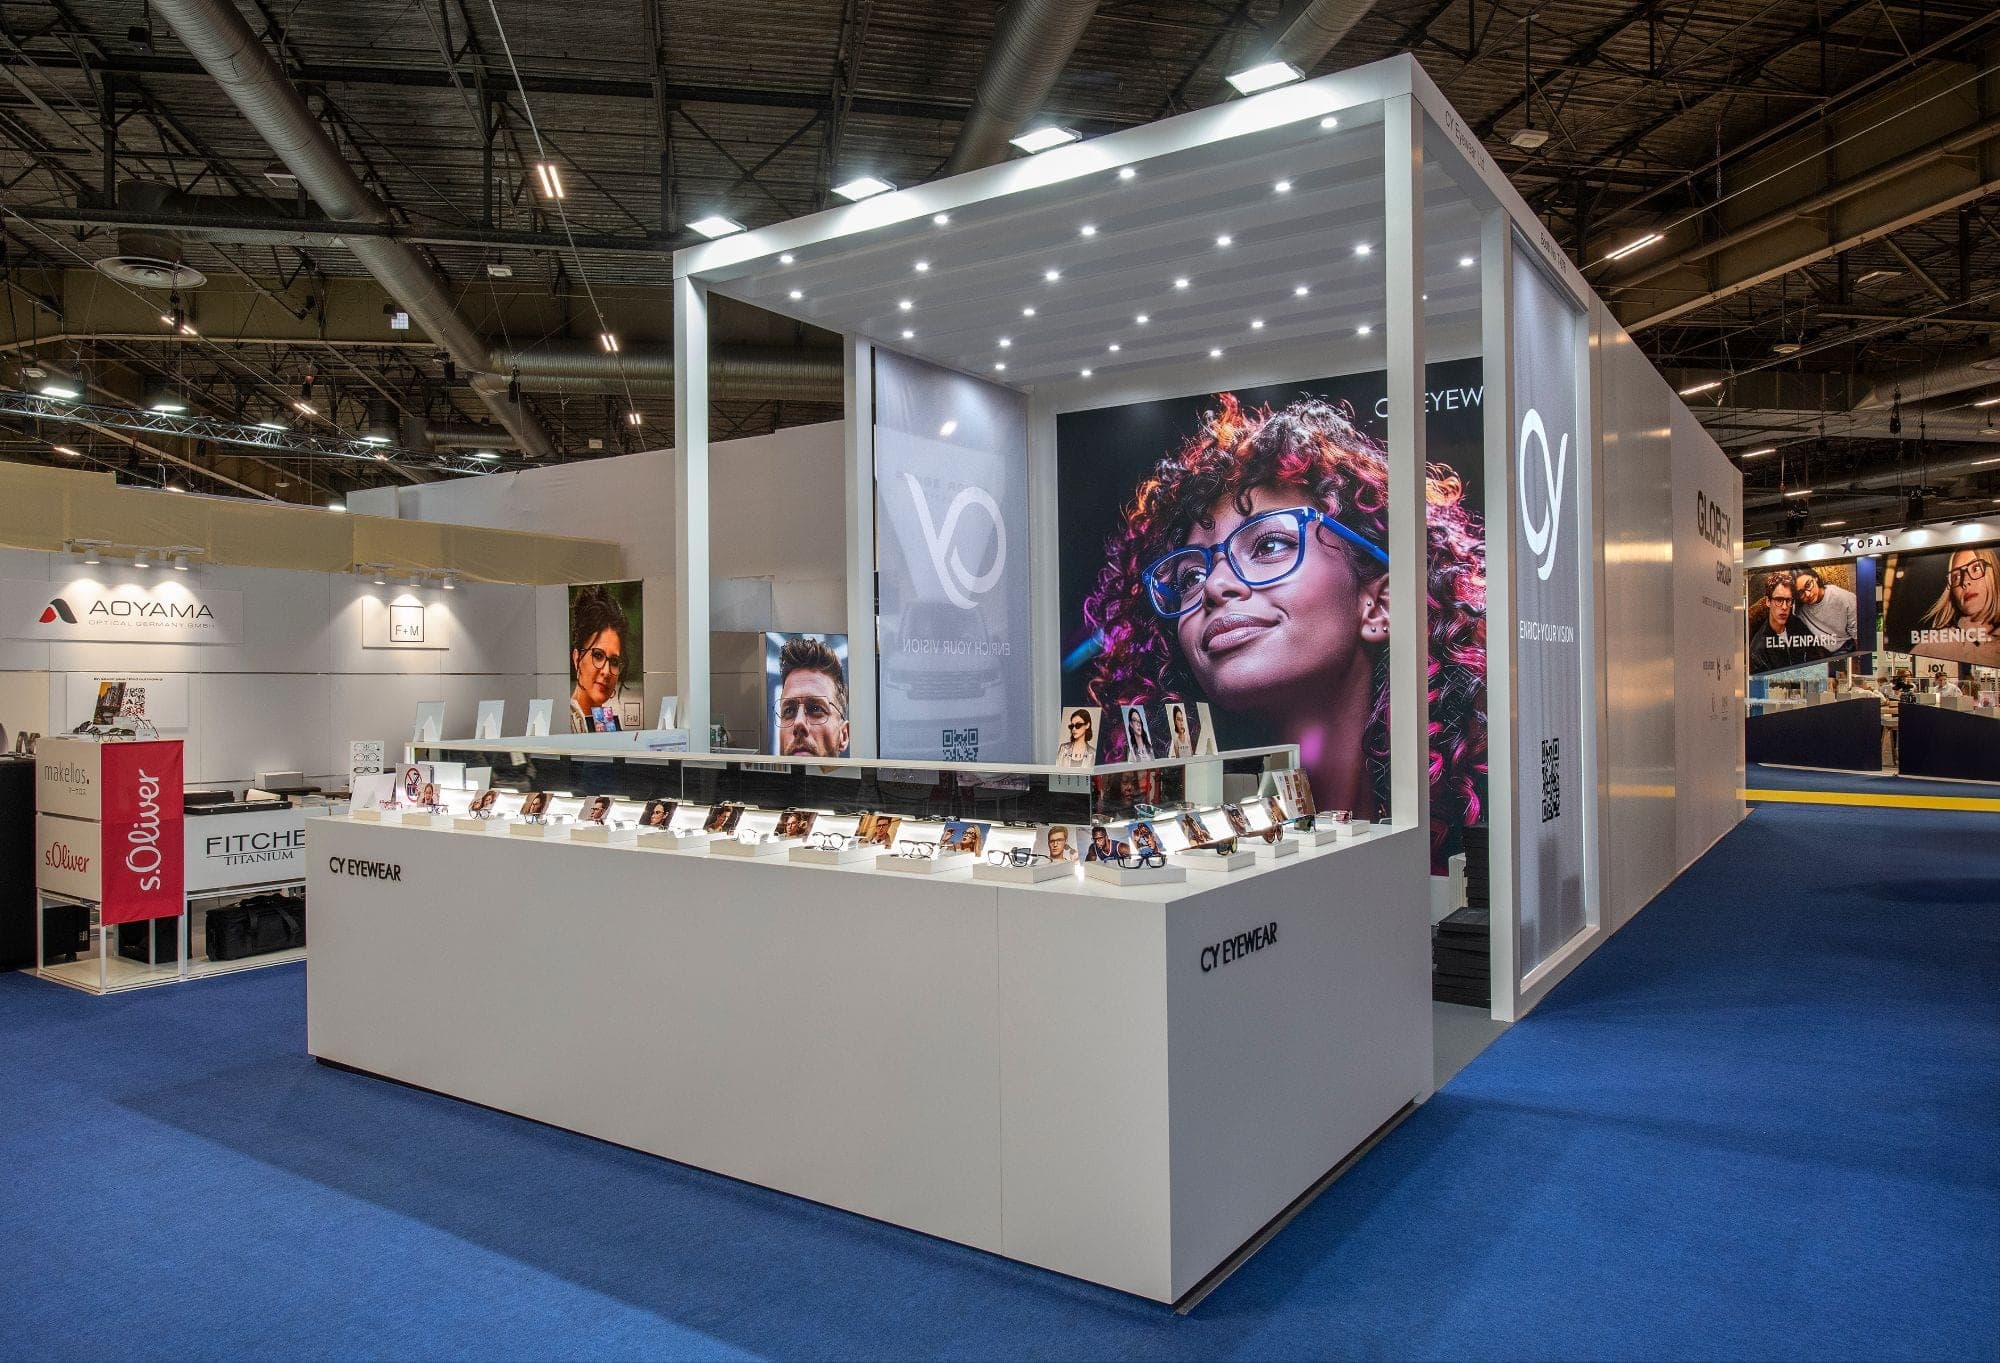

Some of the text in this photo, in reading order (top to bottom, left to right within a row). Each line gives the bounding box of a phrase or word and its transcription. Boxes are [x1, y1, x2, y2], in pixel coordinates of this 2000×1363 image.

[1374, 385, 1484, 418] C YEW
[1697, 489, 1731, 556] GLOBEX
[1857, 536, 1891, 549] OPAL
[89, 599, 215, 619] AOYAMA
[88, 619, 132, 627] OPTICAL
[135, 621, 184, 629] GERMANY
[395, 624, 419, 636] F+M
[1540, 623, 1557, 642] YOUR
[1765, 633, 1838, 649] ELEVENPARIS
[1928, 664, 1945, 673] JOY
[125, 768, 162, 891] s.Oliver
[45, 841, 90, 873] s.Oliver
[223, 850, 295, 866] TITANIUM
[329, 856, 402, 882] CY EYEWEAR
[1200, 921, 1277, 973] CY EYEWEAR
